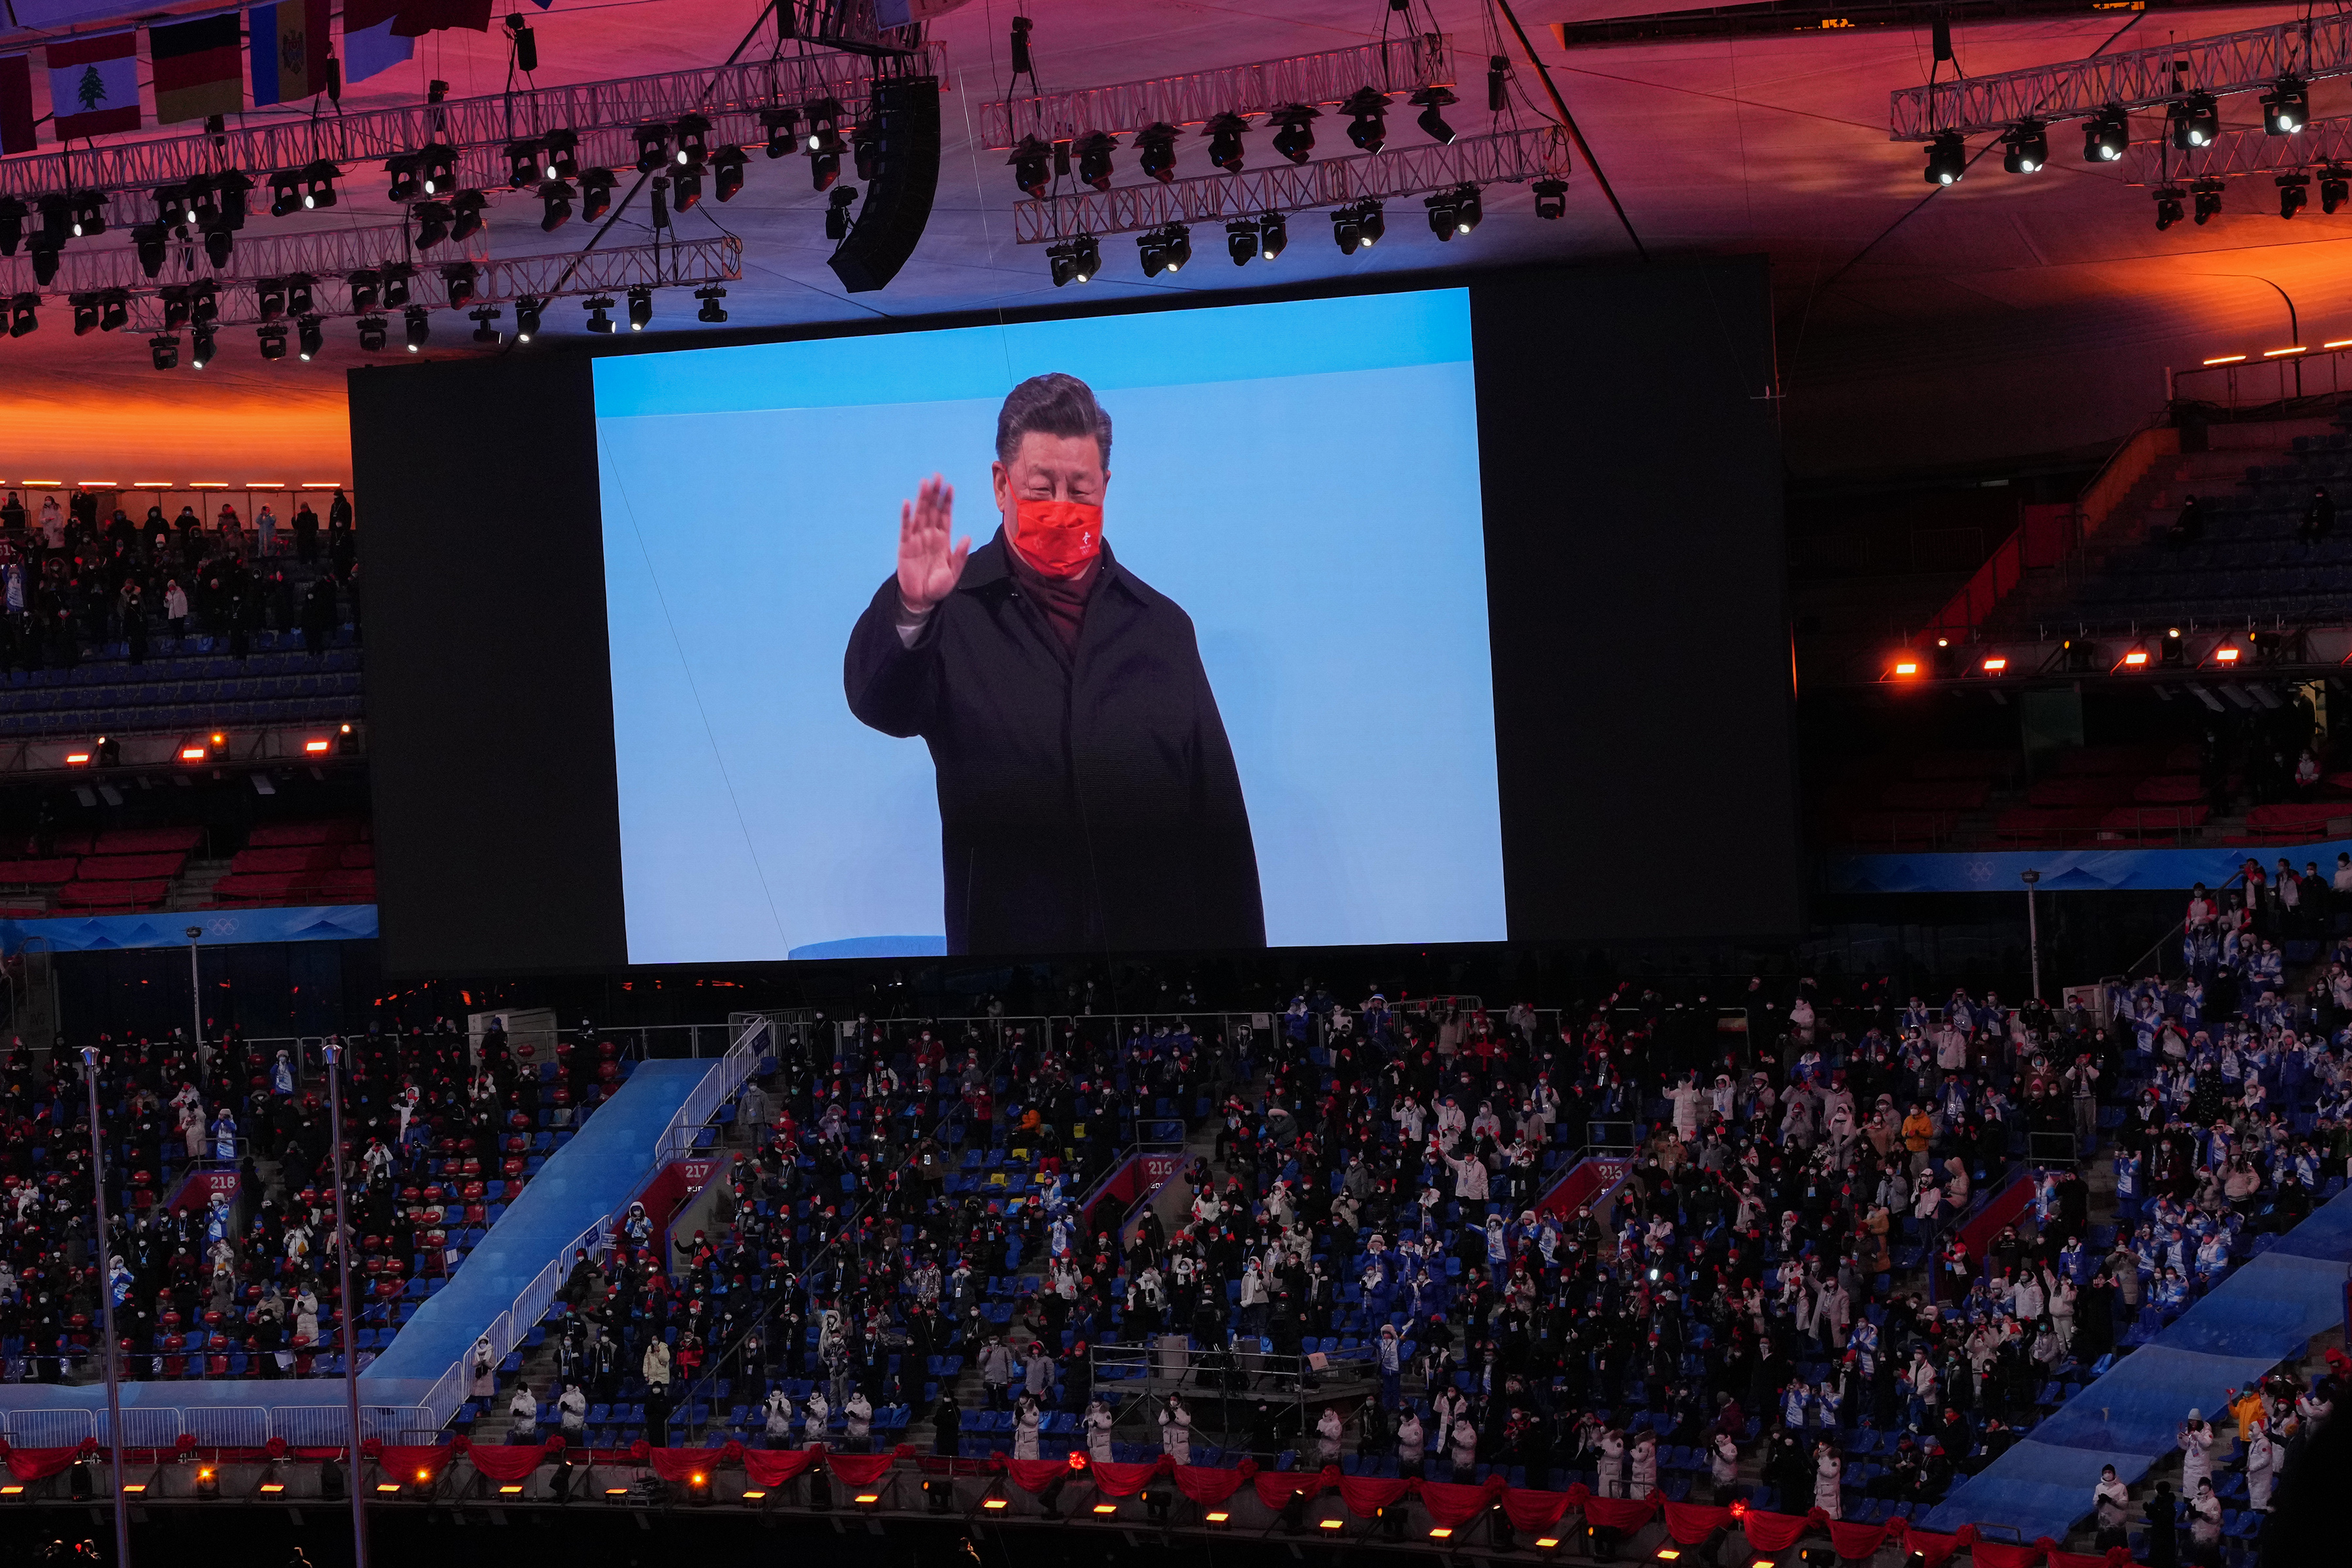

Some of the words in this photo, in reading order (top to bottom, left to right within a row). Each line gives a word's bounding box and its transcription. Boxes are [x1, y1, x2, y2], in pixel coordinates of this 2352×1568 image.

[685, 1165, 709, 1178] 217
[1149, 1161, 1172, 1175] 216
[1599, 1165, 1623, 1180] 215
[210, 1176, 235, 1189] 218
